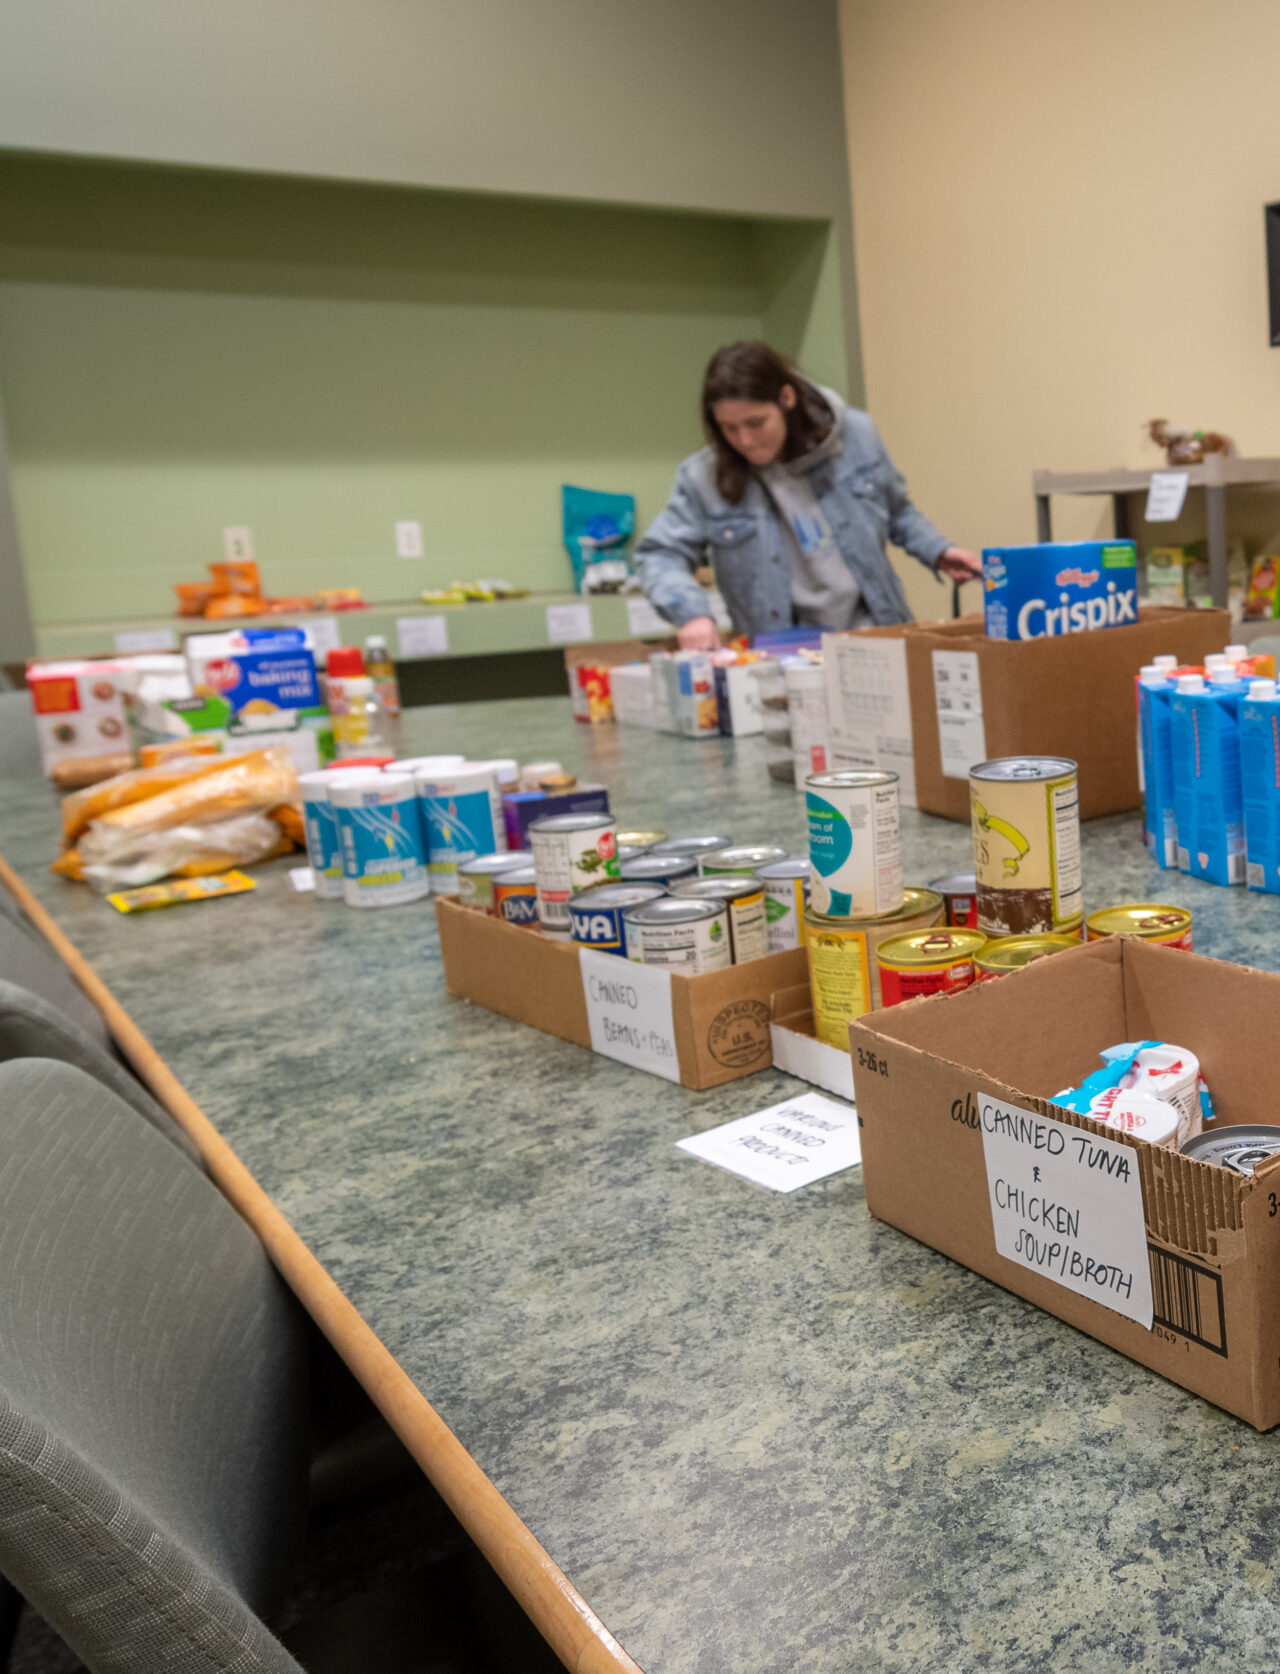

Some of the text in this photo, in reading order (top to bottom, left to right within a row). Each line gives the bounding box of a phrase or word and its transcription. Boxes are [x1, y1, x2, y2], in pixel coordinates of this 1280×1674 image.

[1017, 581, 1136, 641] Crispix
[247, 669, 310, 687] baking
[571, 914, 613, 939] YA
[588, 975, 638, 1010] CANNED
[603, 1016, 641, 1049] BEANS
[857, 1047, 889, 1078] 3-26 ct
[760, 1122, 826, 1148] CANNED
[982, 1105, 1132, 1183] CANNED TUNA
[995, 1178, 1079, 1239] CHICKEN
[1014, 1228, 1133, 1299] SOUP/BROTH
